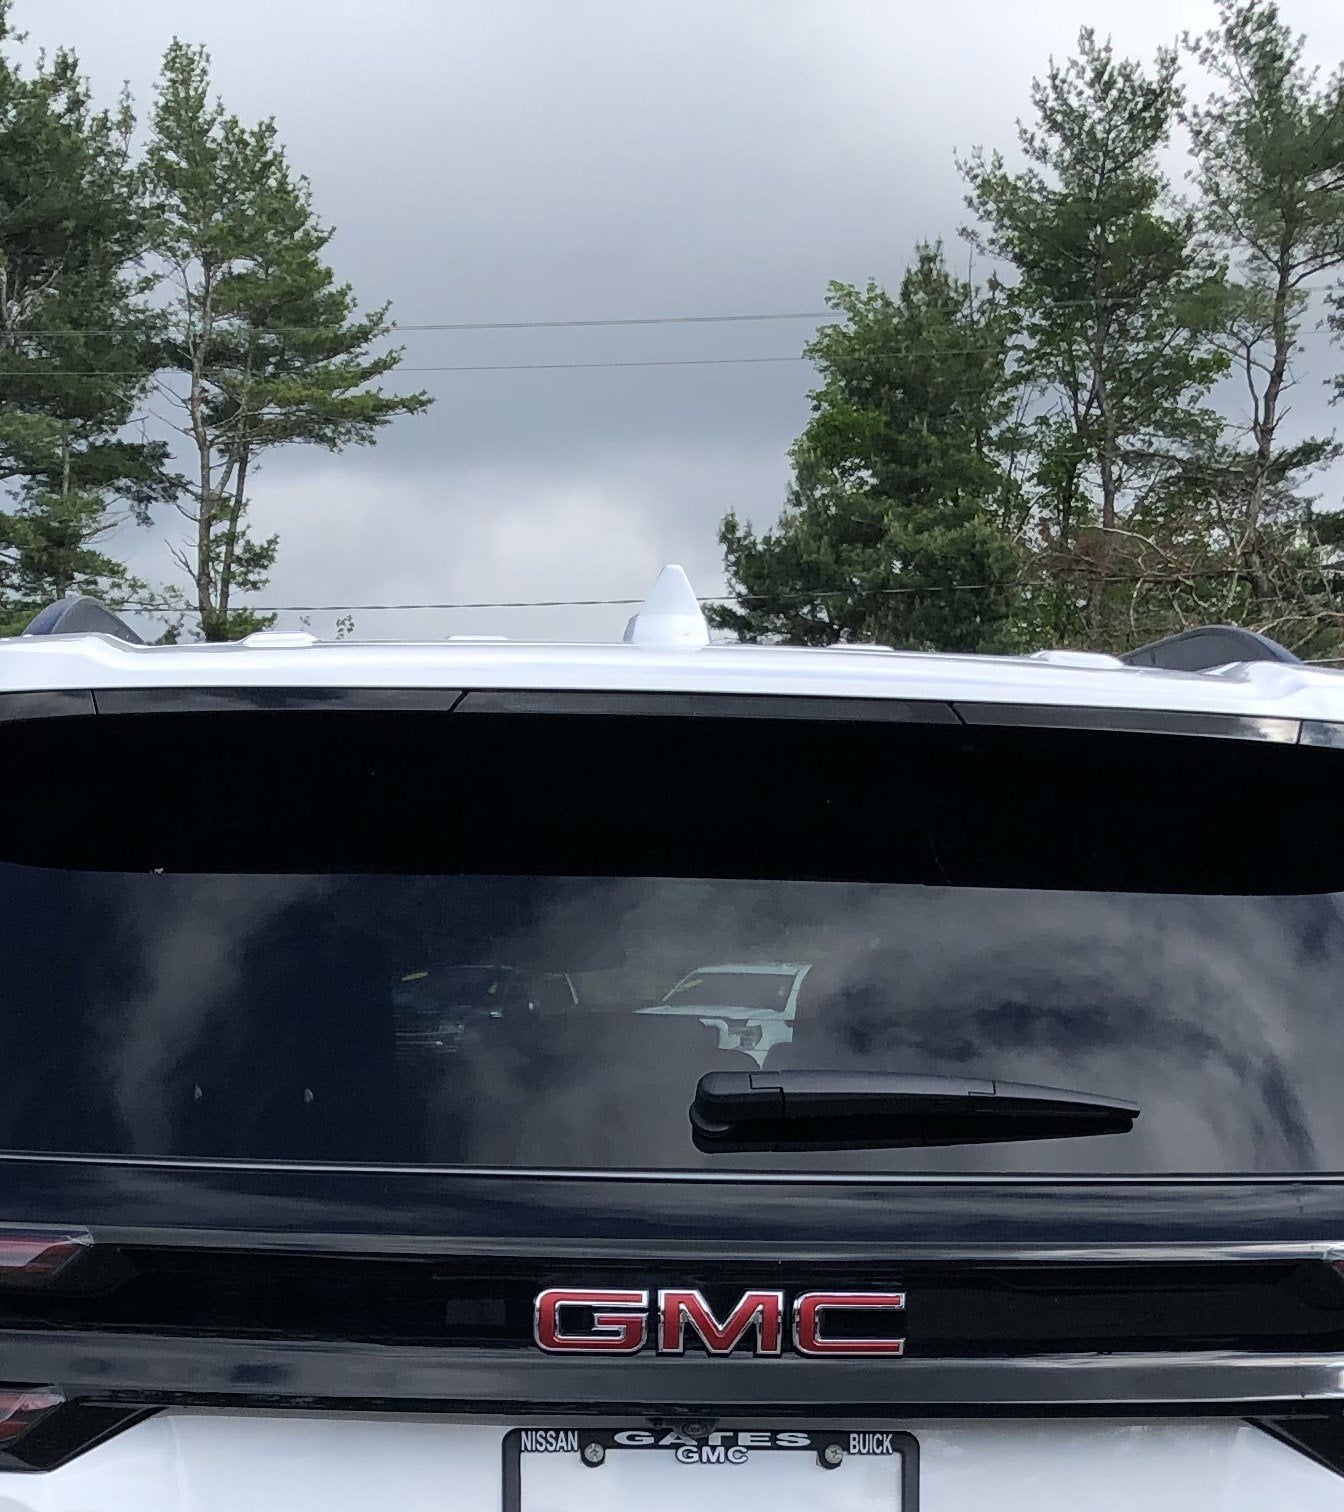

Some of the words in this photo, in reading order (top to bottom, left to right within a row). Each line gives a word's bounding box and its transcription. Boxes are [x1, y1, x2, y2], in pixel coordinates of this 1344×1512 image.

[534, 1290, 906, 1354] GMC
[521, 1431, 578, 1452] NISSAN
[613, 1431, 812, 1447] GATES
[849, 1434, 893, 1454] BUICK
[676, 1446, 748, 1463] GMC
